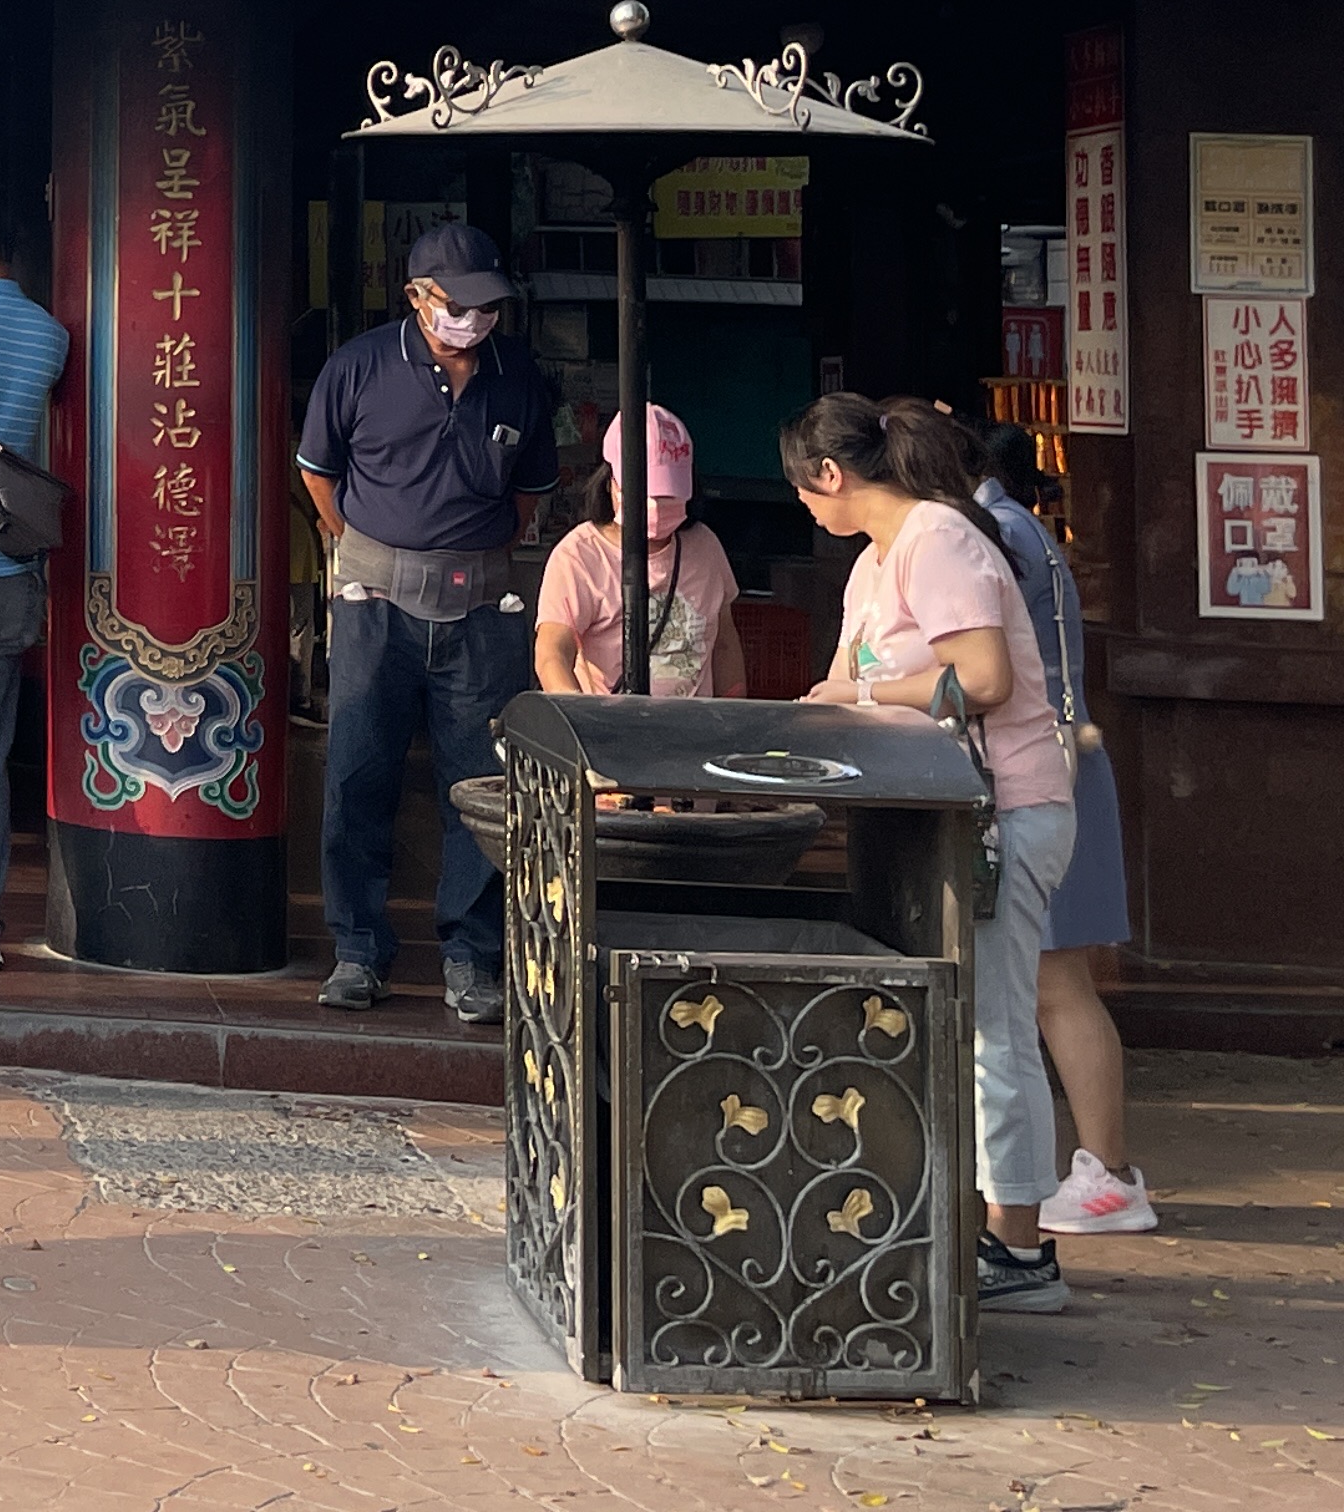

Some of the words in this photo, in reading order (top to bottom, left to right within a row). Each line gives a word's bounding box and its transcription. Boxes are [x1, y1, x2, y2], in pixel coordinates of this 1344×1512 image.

[1232, 304, 1265, 439] 小心扒手
[1268, 304, 1299, 441] 人多擁擠
